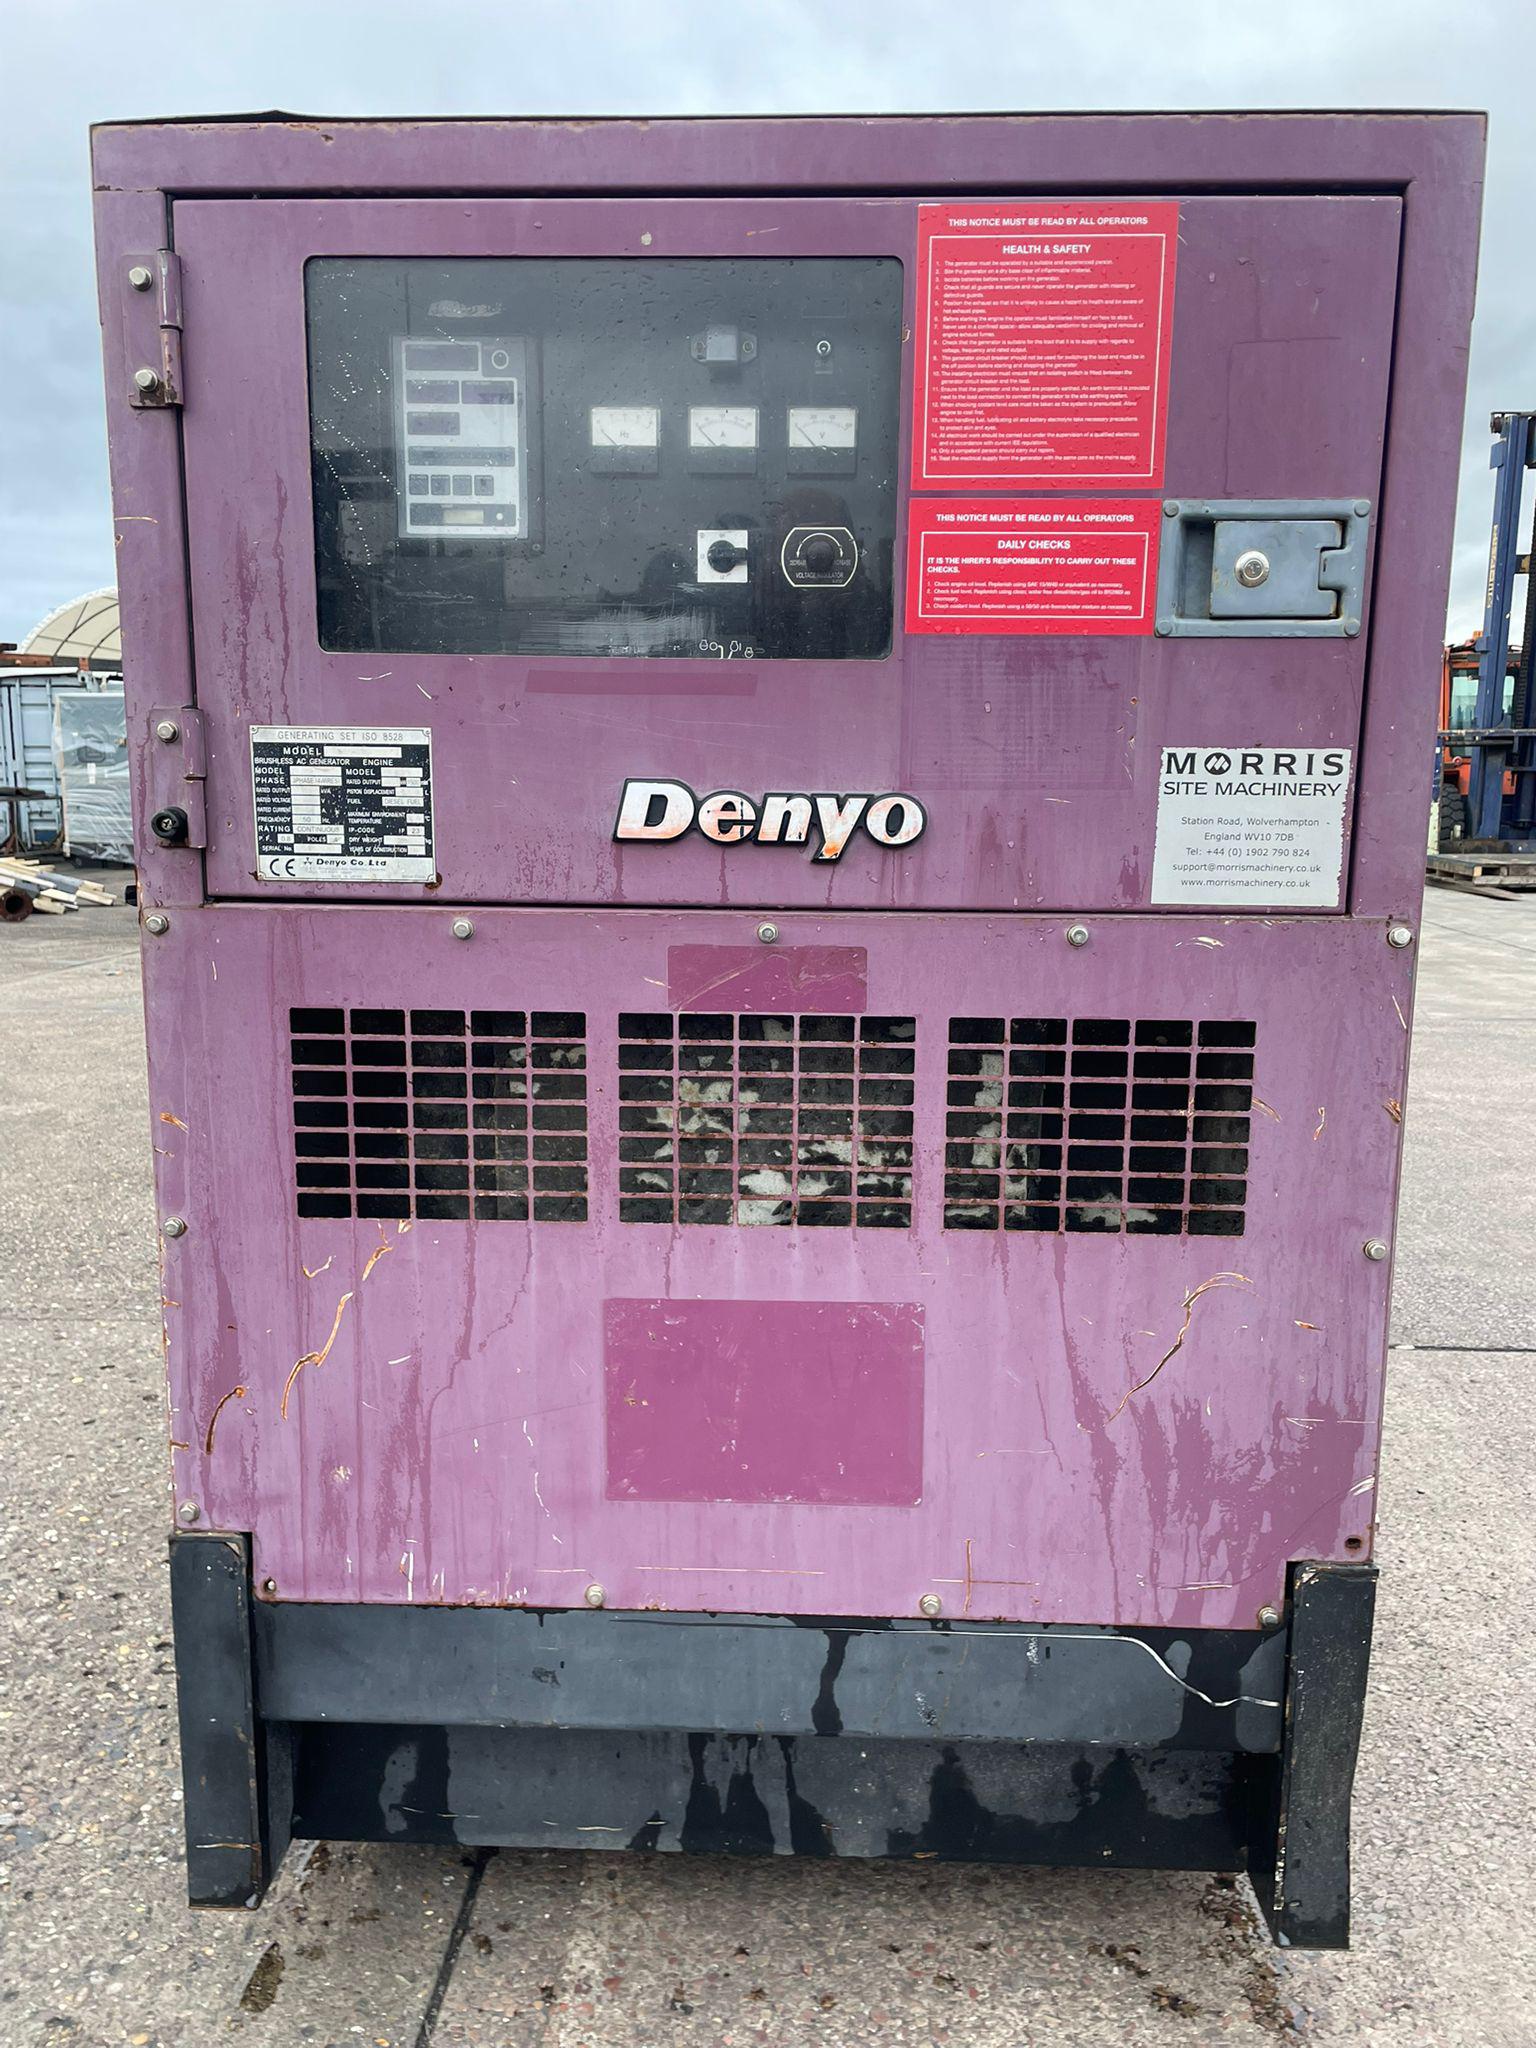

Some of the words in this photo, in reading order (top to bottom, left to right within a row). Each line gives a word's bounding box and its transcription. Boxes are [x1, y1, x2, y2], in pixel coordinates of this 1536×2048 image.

[949, 218, 967, 226] THIS
[969, 218, 1000, 226] NOTICE
[1002, 218, 1026, 226] MUST
[1079, 217, 1095, 225] ALL
[1097, 217, 1148, 225] OPERATORS
[1003, 245, 1041, 254] HEALTH
[1043, 245, 1051, 253] &
[1053, 245, 1091, 253] SAFETY
[936, 514, 955, 522] THIS
[957, 514, 987, 522] NOTICE
[989, 514, 1013, 522] MUST
[1015, 514, 1027, 522] BE
[1029, 514, 1051, 522] READ
[1053, 514, 1065, 522] BY
[1066, 514, 1082, 522] ALL
[1084, 514, 1134, 522] OPERATORS
[998, 540, 1026, 549] DAILY
[1029, 540, 1071, 549] CHECKS
[993, 557, 1053, 565] RESPONSIBILITY
[1055, 557, 1065, 565] TO
[1067, 557, 1093, 565] CARRY
[927, 566, 960, 574] CHECKS.
[278, 732, 334, 740] GENERATING
[383, 733, 403, 741] 8528
[283, 747, 322, 755] MODEL
[1165, 752, 1344, 776] MORRIS
[1164, 781, 1207, 795] SITE
[1215, 782, 1342, 796] MACHINERY
[613, 777, 927, 863] Denyo
[1181, 817, 1214, 825] Station
[1217, 817, 1243, 827] Road,
[1247, 818, 1320, 827] Wolverhampton
[1204, 833, 1241, 843] England
[1244, 833, 1272, 841] WV10
[1275, 833, 1294, 841] 7DB
[1186, 848, 1202, 856] Tel:
[1206, 848, 1224, 856] +44
[1228, 848, 1242, 858] (0)
[1272, 849, 1290, 857] 790
[1292, 849, 1310, 857] 824
[1172, 863, 1321, 873] support@morrismachinery.co.uk
[1181, 879, 1311, 889] www.morrismachinery.co.uk
